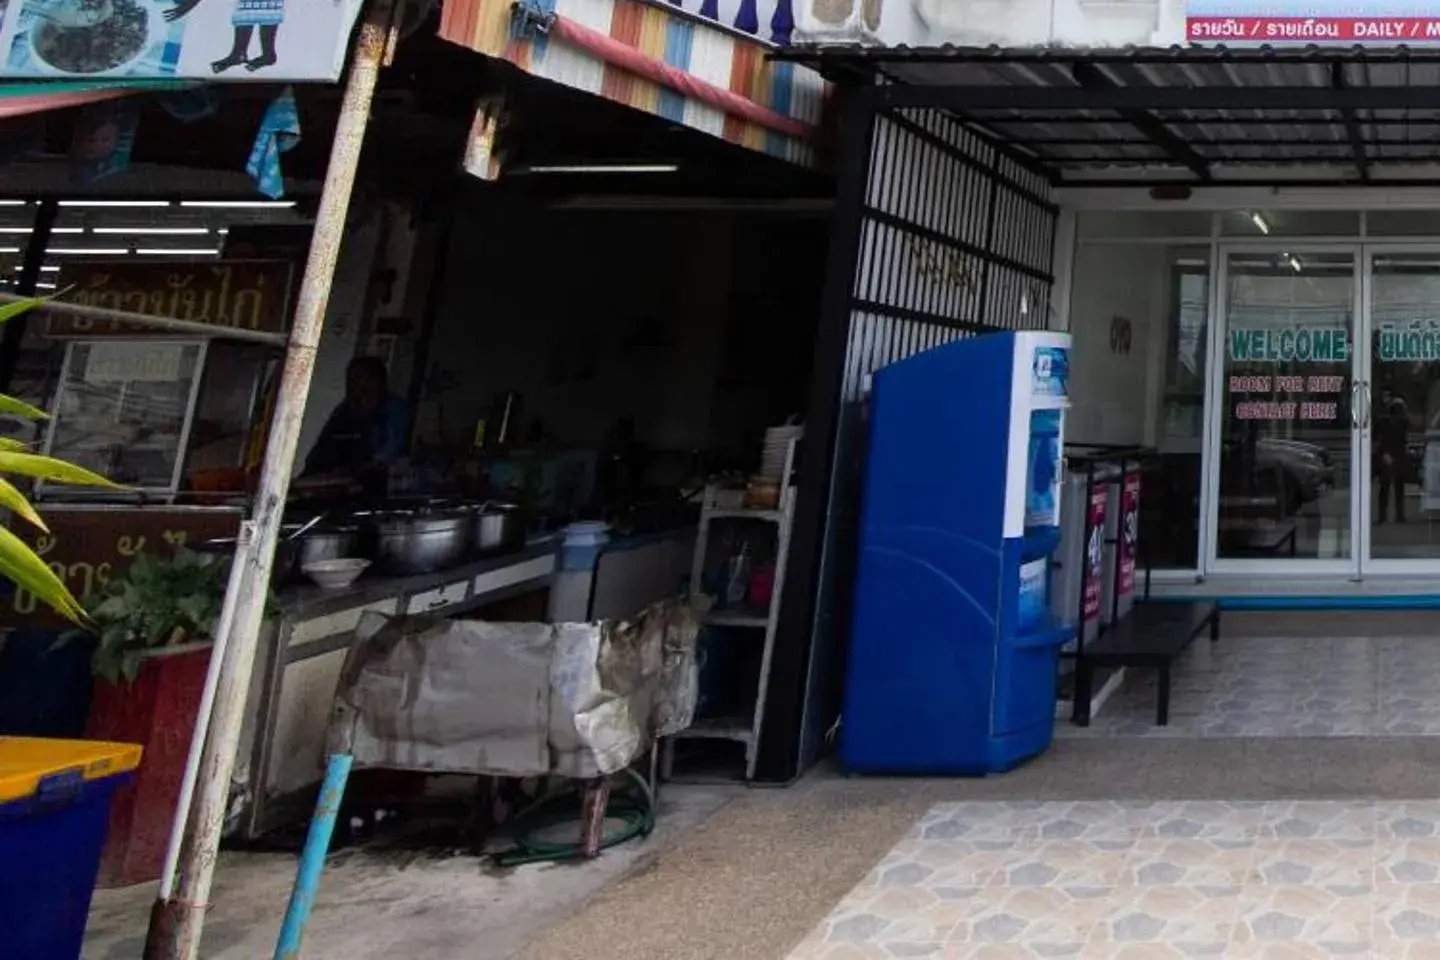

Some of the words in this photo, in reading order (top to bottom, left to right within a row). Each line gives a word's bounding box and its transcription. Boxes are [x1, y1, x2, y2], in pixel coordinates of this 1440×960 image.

[1191, 19, 1246, 37] รายวัน
[1266, 19, 1340, 38] รายเดือน
[1353, 21, 1405, 37] DAILY
[1230, 328, 1349, 363] WELCOME
